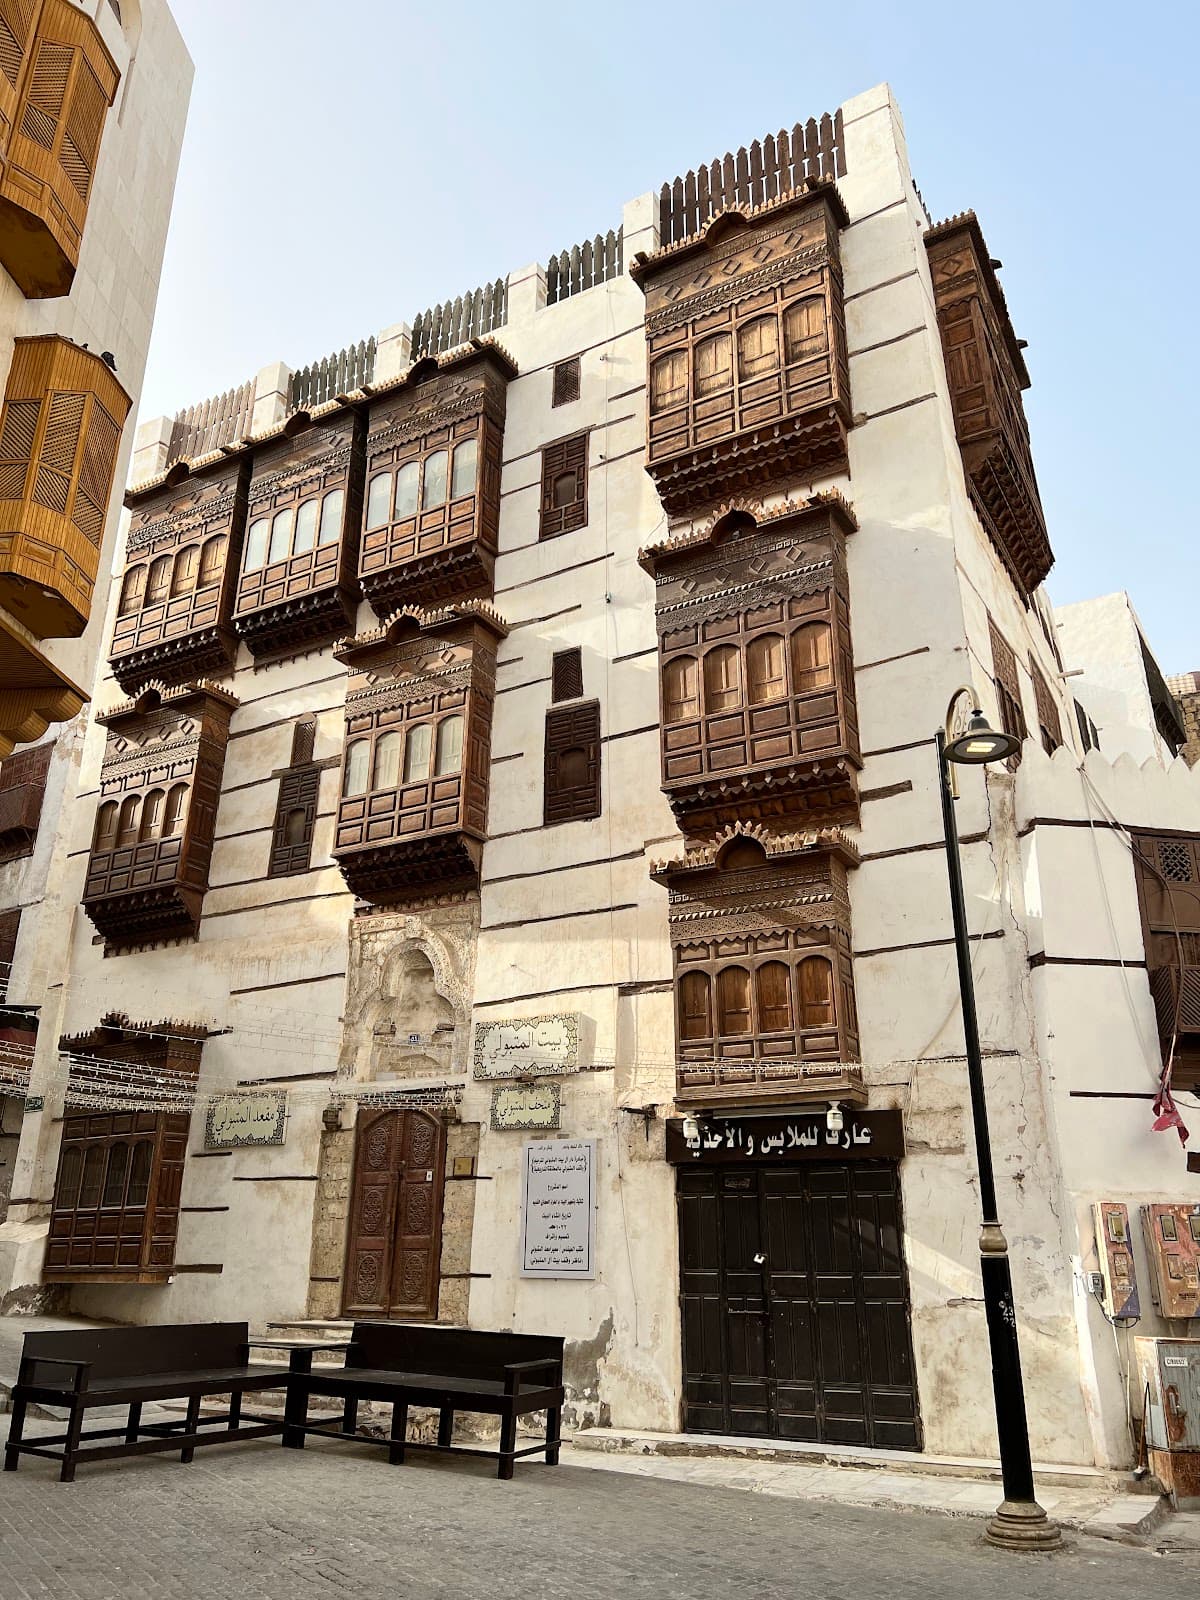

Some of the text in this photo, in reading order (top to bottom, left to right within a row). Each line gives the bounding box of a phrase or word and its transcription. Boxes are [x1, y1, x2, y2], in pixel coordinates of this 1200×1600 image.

[489, 1031, 562, 1065] بيت المتبولي
[215, 1105, 275, 1136] مقعد المتبولي
[499, 1095, 551, 1120] متحف المتبولي
[760, 1124, 819, 1156] للملابس
